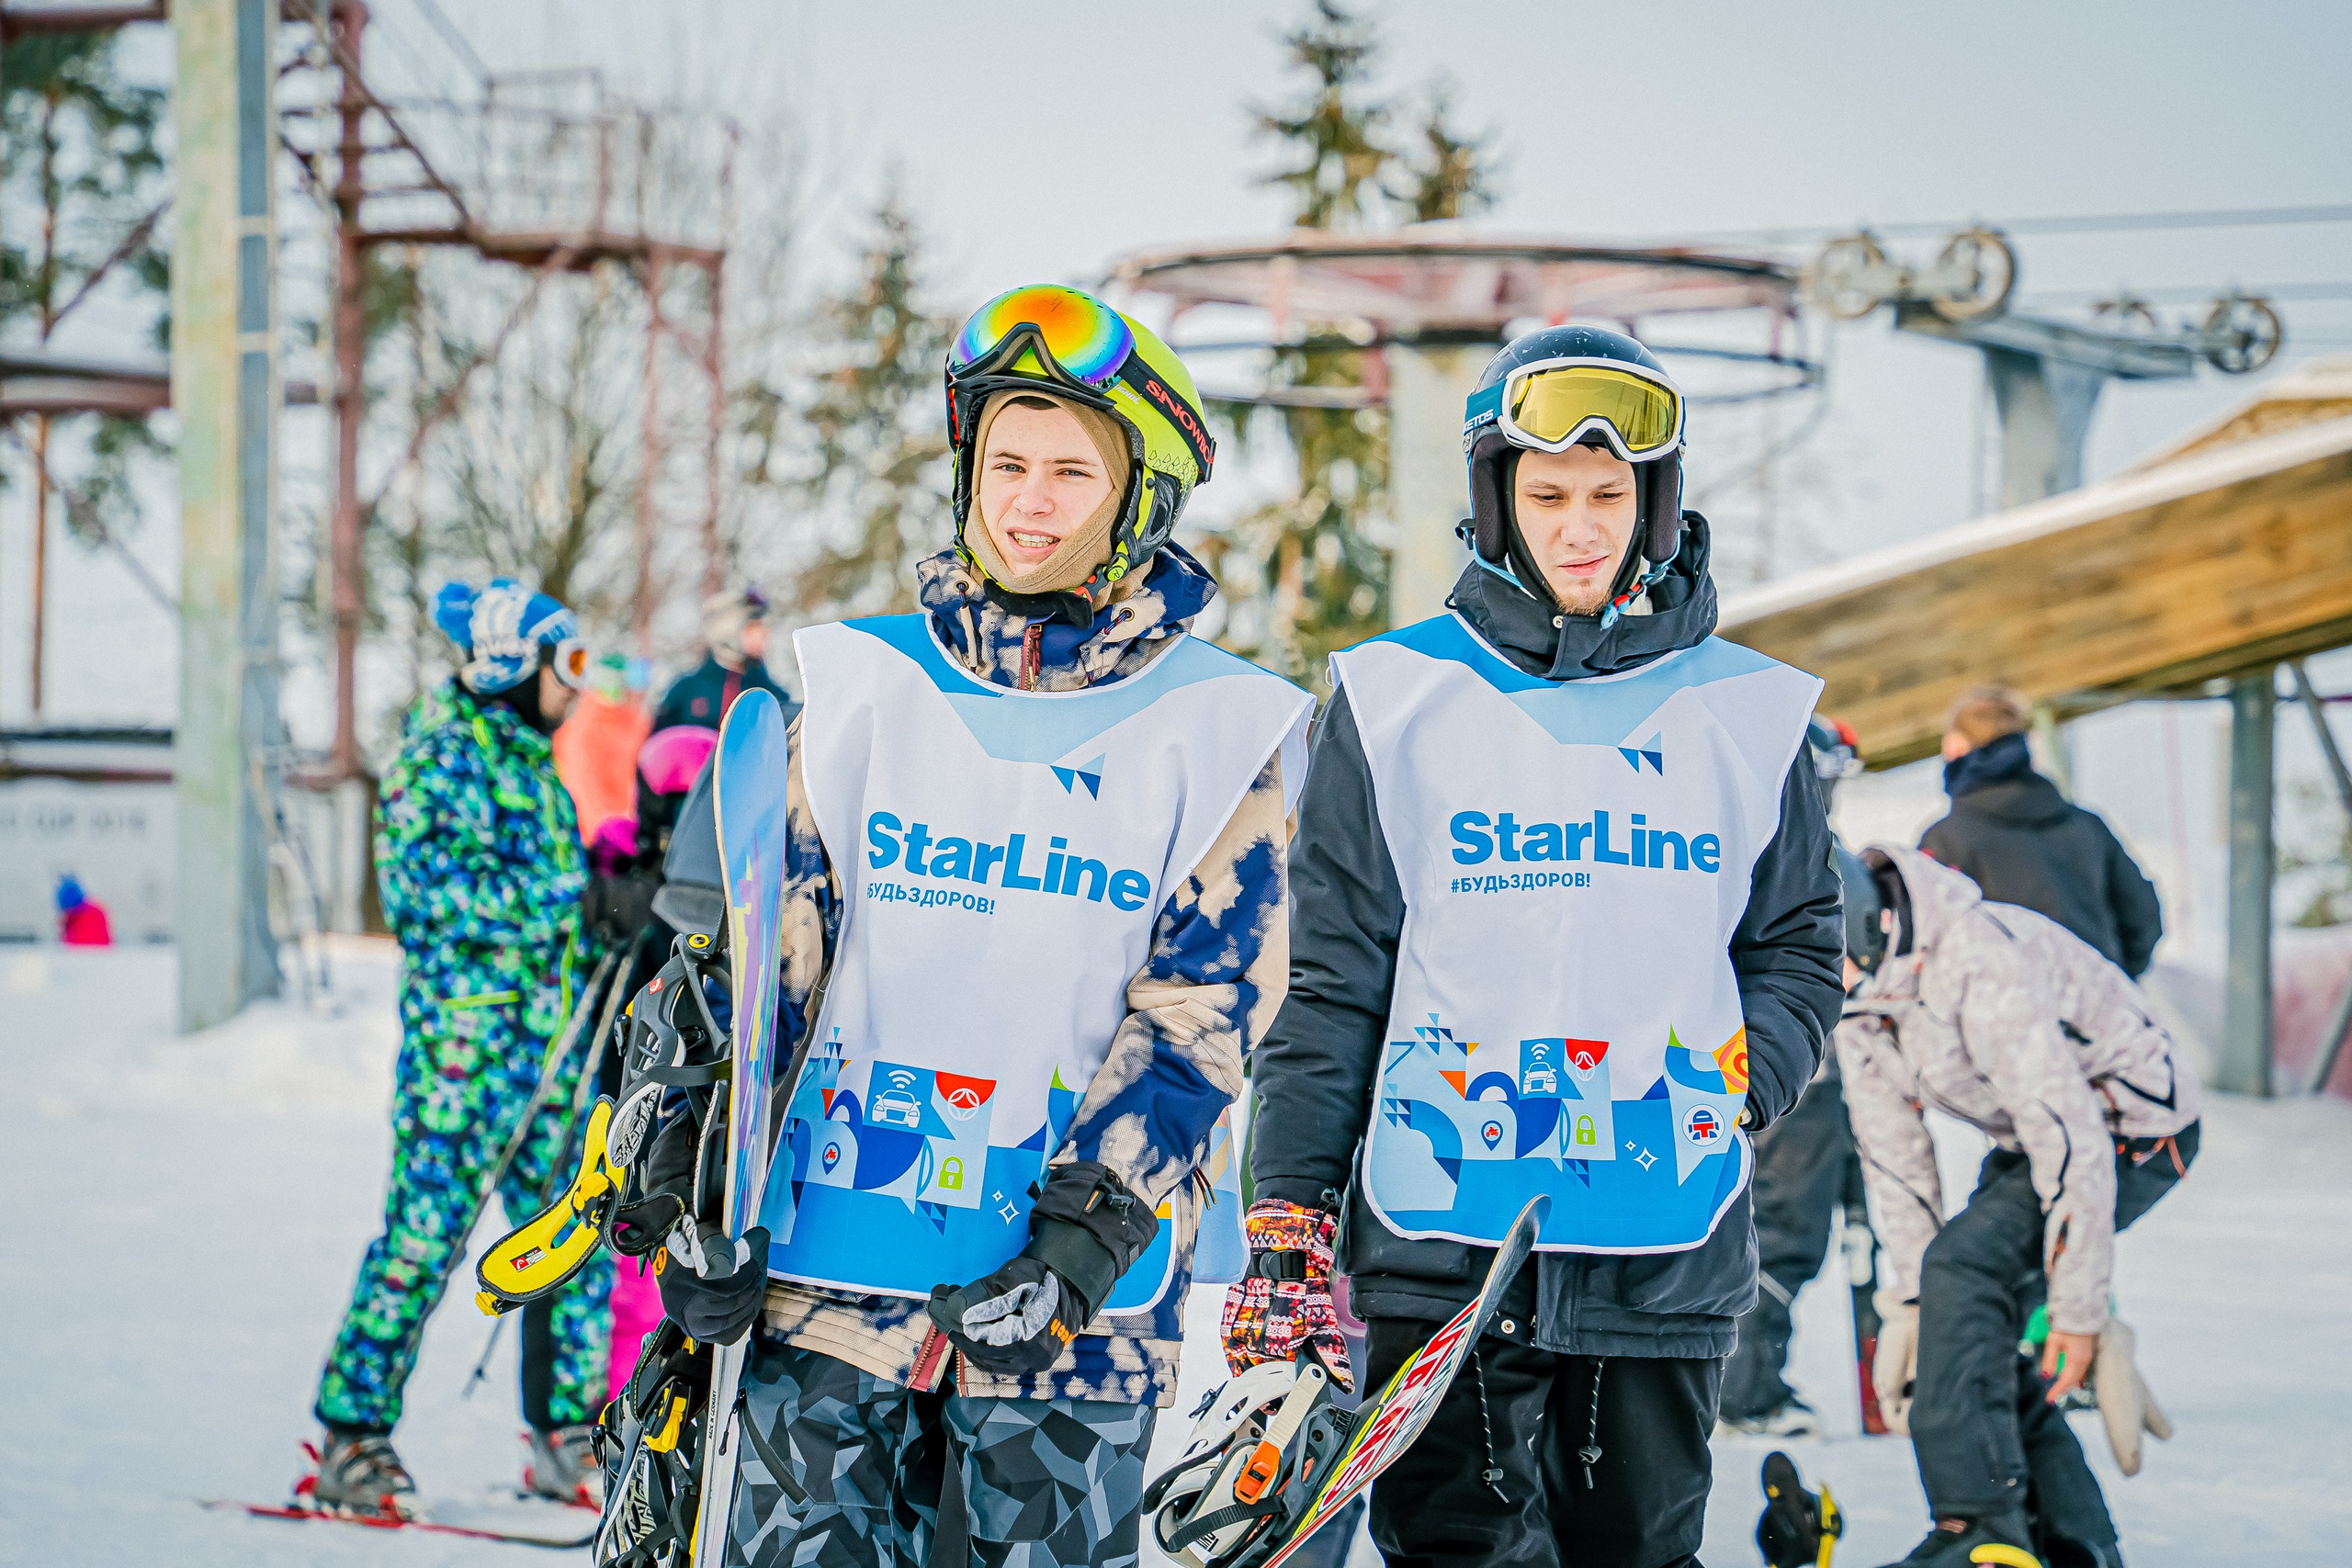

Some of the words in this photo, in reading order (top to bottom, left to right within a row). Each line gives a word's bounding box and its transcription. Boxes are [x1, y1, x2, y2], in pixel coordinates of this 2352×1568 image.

[867, 811, 1151, 912] StarLine
[1449, 809, 1721, 874] StarLine
[866, 882, 995, 916] БУДЬЗДОРОВ!
[1451, 872, 1591, 895] #БУДЬЗДОРОВ!
